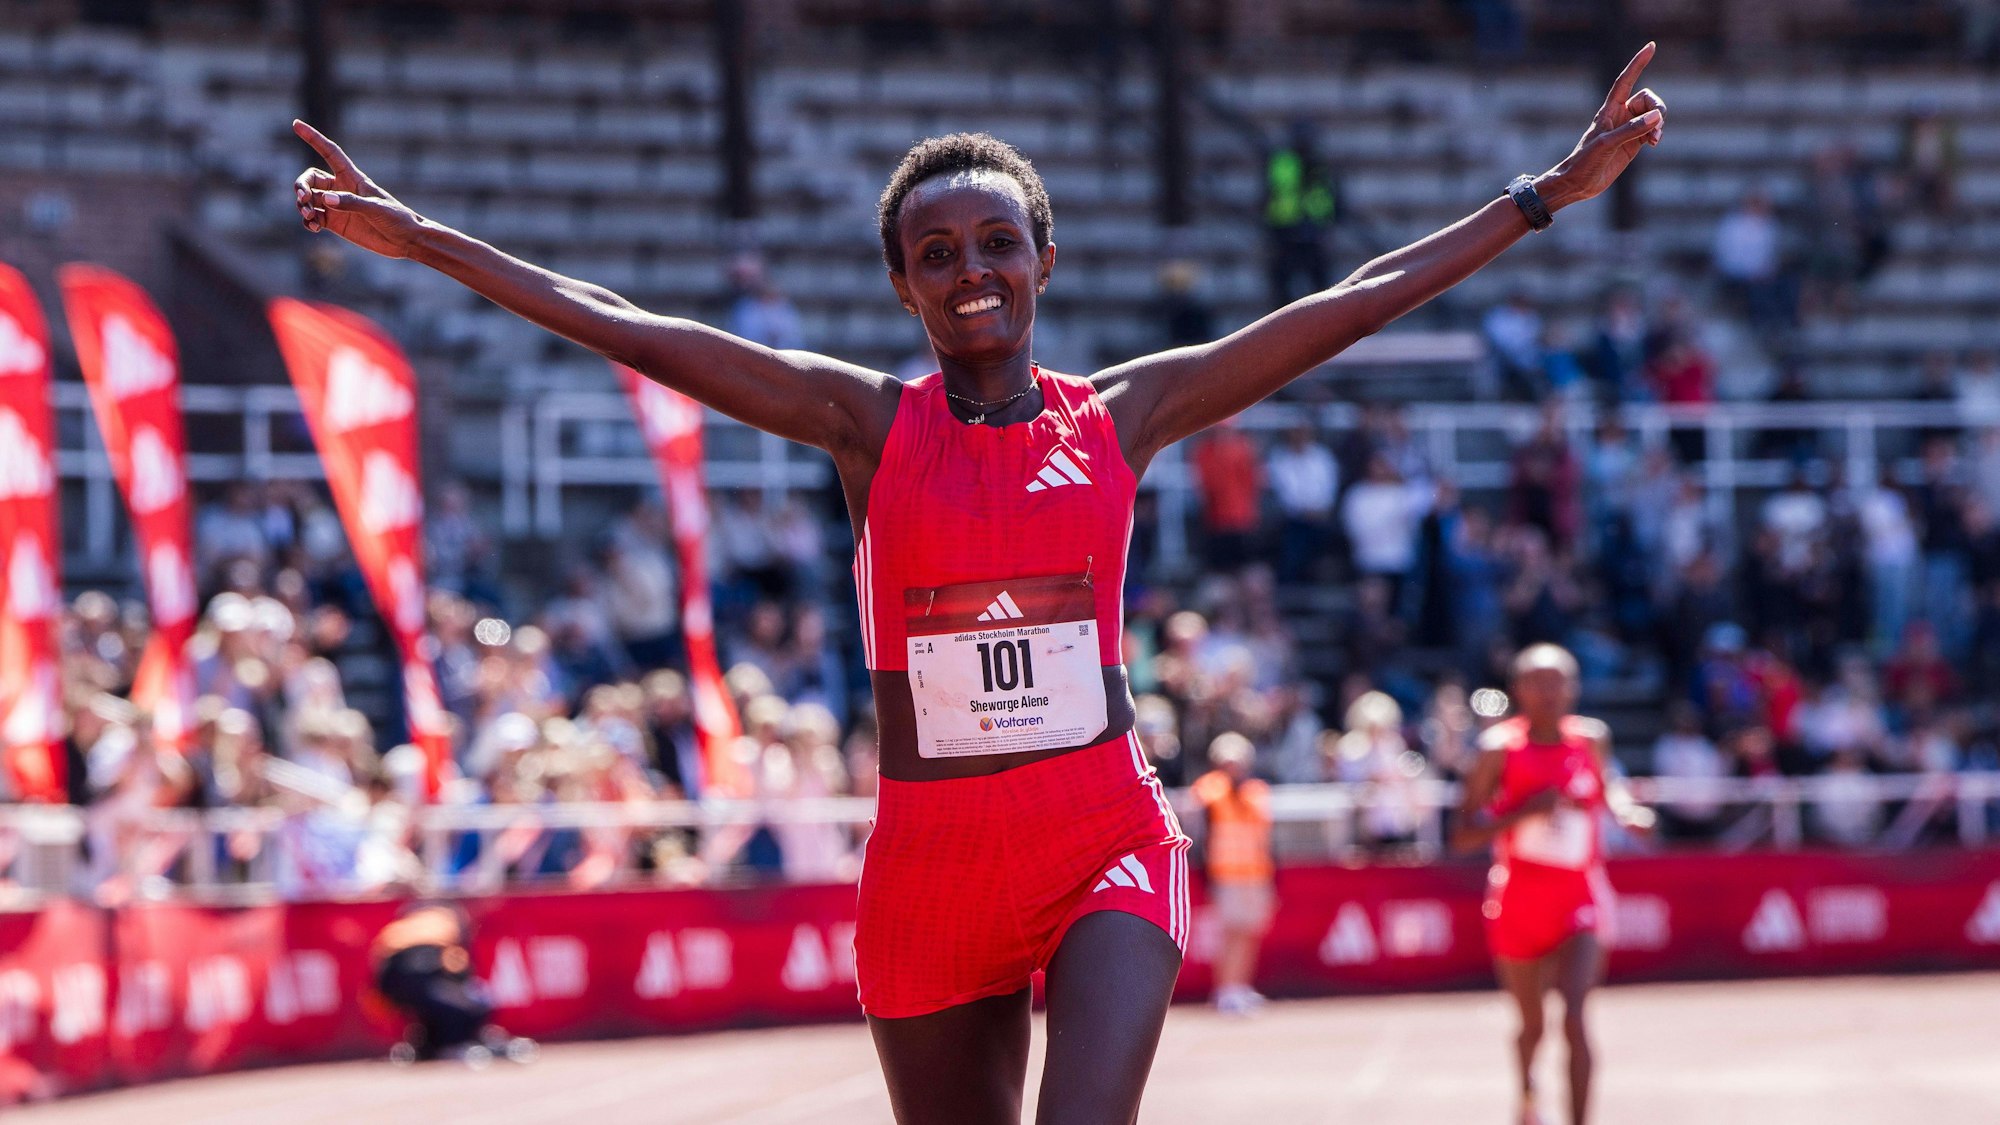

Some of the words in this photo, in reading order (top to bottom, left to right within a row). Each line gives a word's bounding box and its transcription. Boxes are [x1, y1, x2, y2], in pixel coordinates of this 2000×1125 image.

[954, 633, 977, 642] adidas
[978, 630, 1015, 640] Stockholm
[1016, 627, 1050, 637] Marathon
[927, 642, 934, 654] A
[976, 638, 1034, 693] 101
[970, 699, 1019, 713] Shewarge
[1021, 695, 1049, 708] Alene
[922, 708, 928, 716] S
[994, 716, 1044, 729] Voltaren
